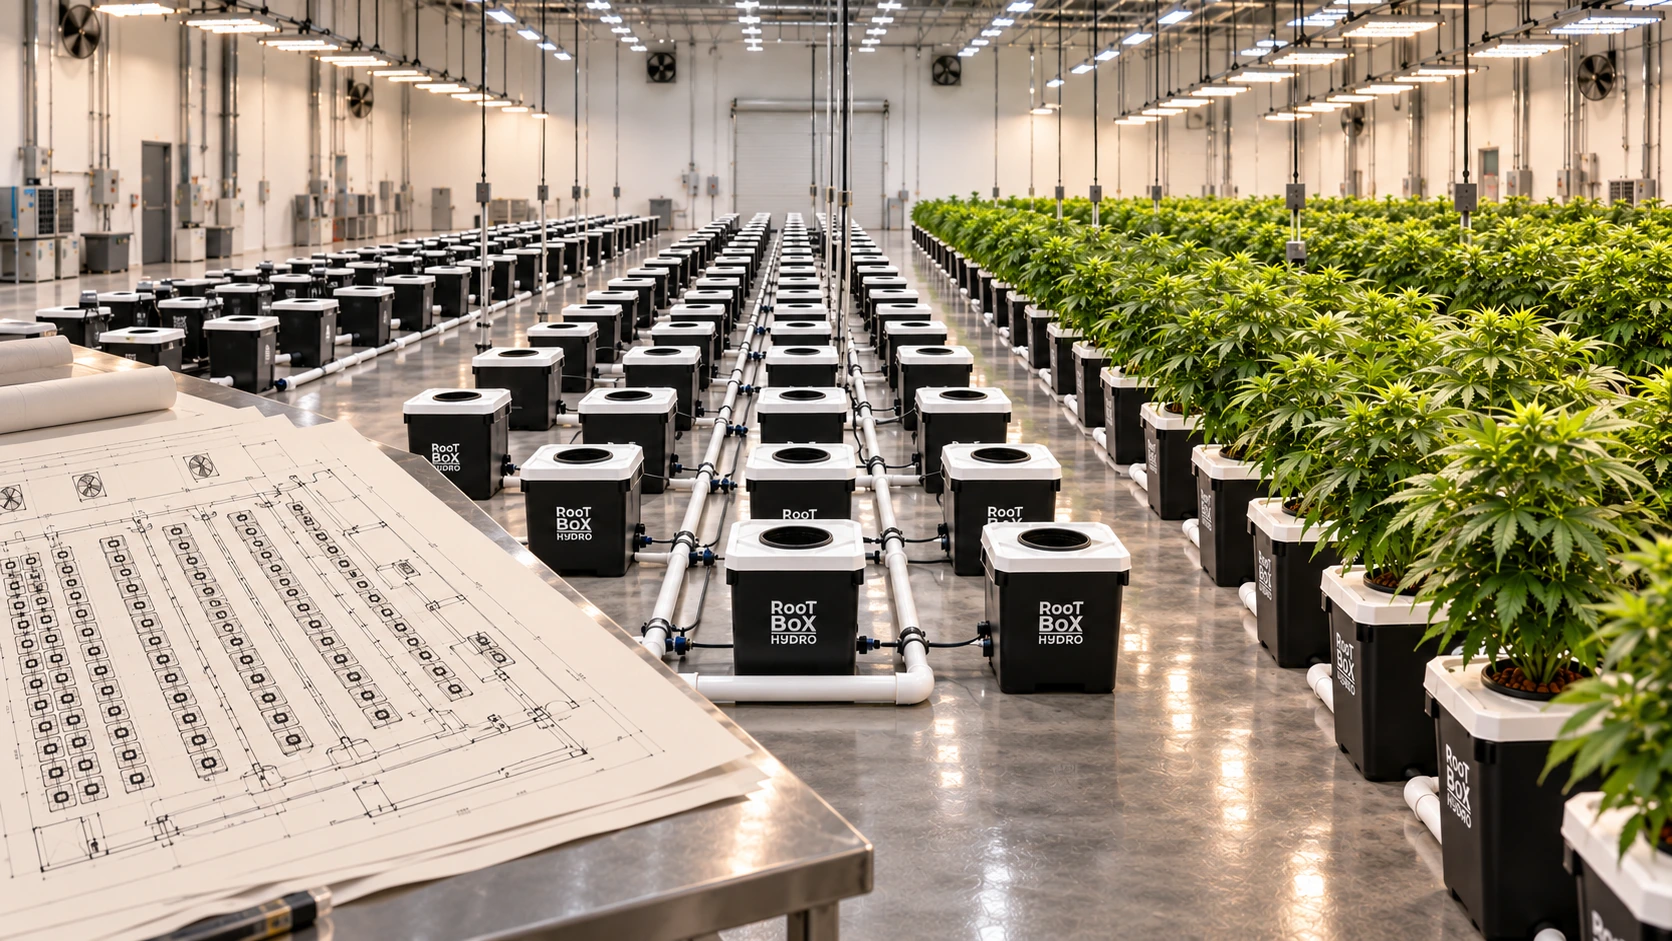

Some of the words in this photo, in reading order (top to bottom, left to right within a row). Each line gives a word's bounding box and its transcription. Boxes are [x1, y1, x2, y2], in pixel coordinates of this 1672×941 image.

[556, 533, 593, 541] HYDRO
[771, 634, 817, 645] HYDRO
[1038, 634, 1084, 645] HYDRO
